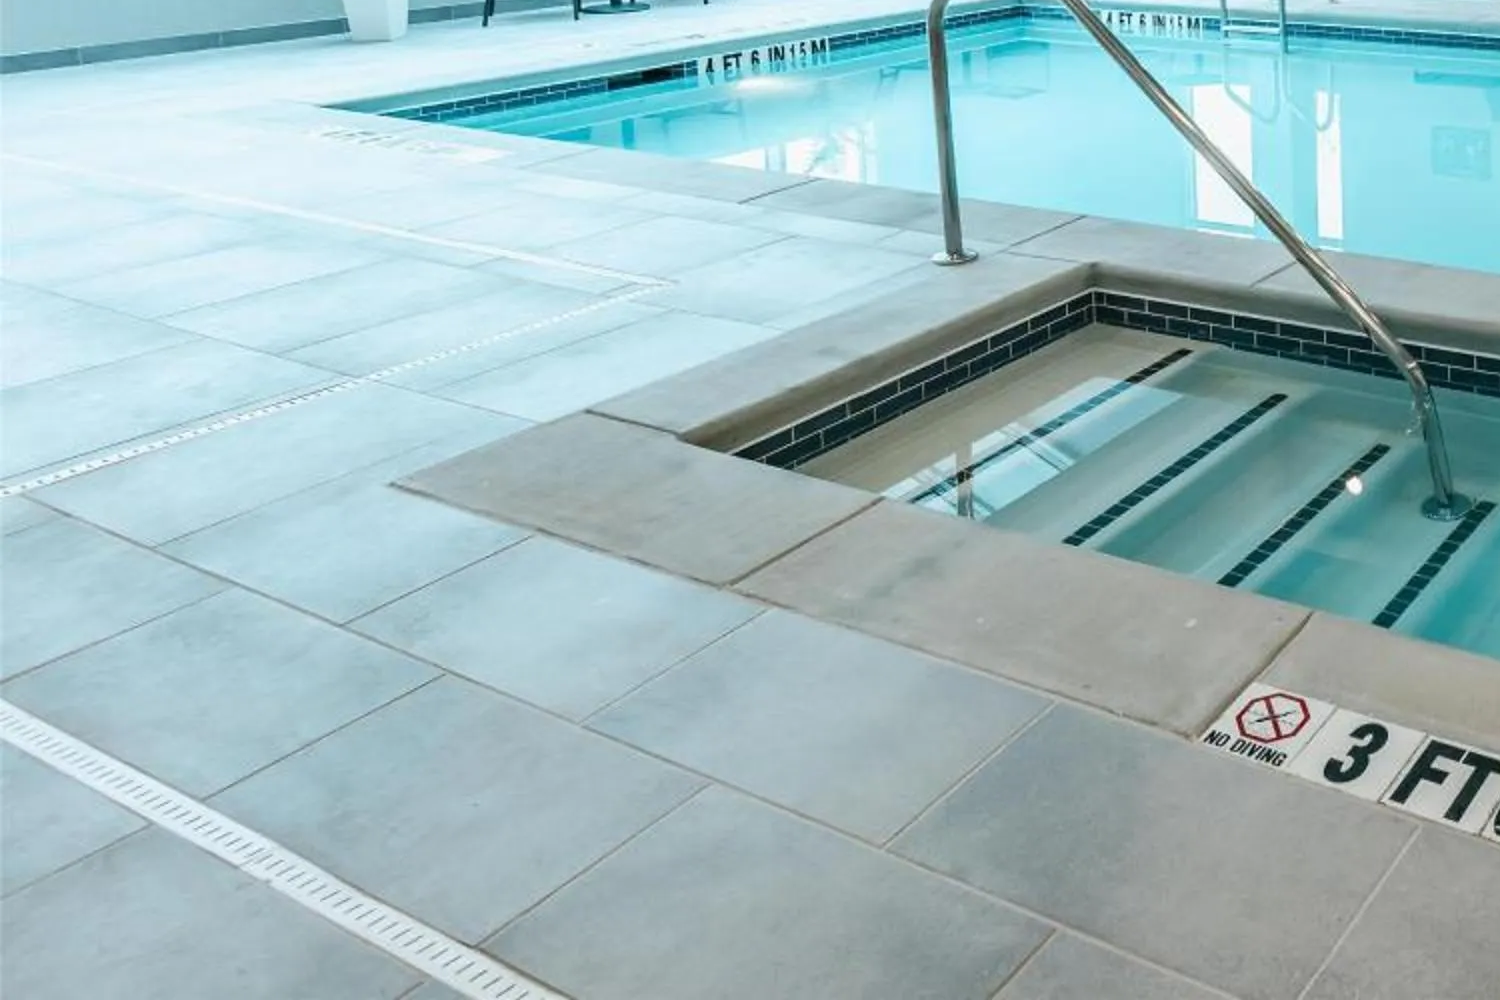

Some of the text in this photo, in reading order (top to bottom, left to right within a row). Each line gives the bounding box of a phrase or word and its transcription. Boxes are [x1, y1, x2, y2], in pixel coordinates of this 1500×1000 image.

[1203, 730, 1288, 768] NO DIVING
[1323, 723, 1389, 784] 3
